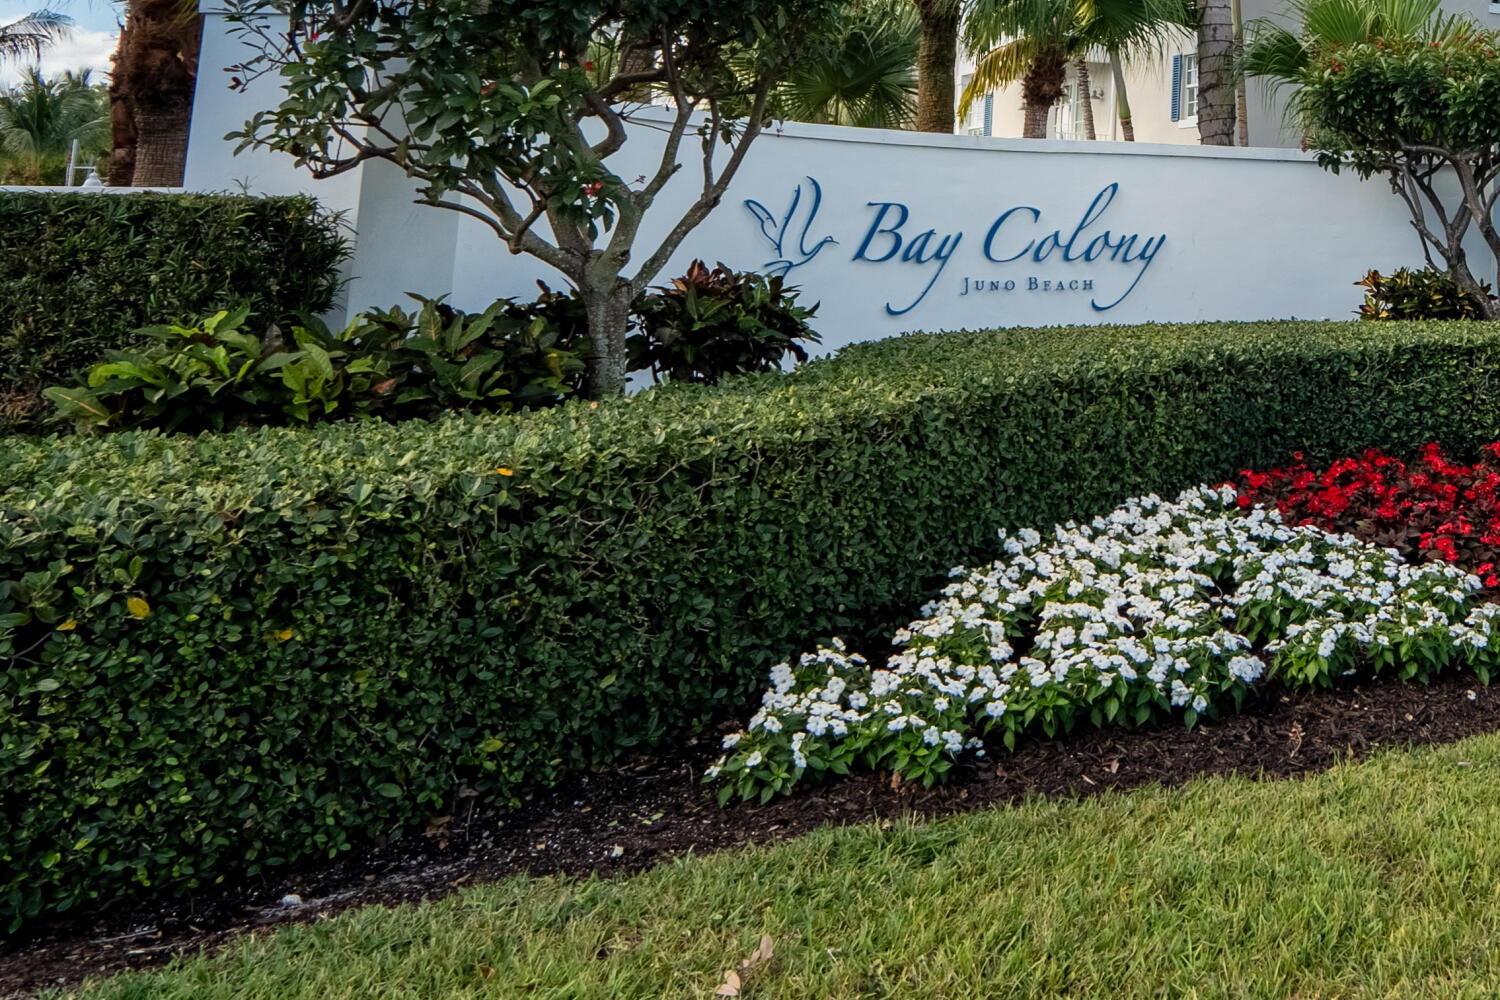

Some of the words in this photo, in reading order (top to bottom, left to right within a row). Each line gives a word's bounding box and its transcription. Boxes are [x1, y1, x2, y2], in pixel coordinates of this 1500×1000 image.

[852, 202, 963, 315] Bay
[983, 182, 1166, 312] Colony
[960, 276, 1016, 296] JUNO
[1027, 276, 1094, 292] BEACH
